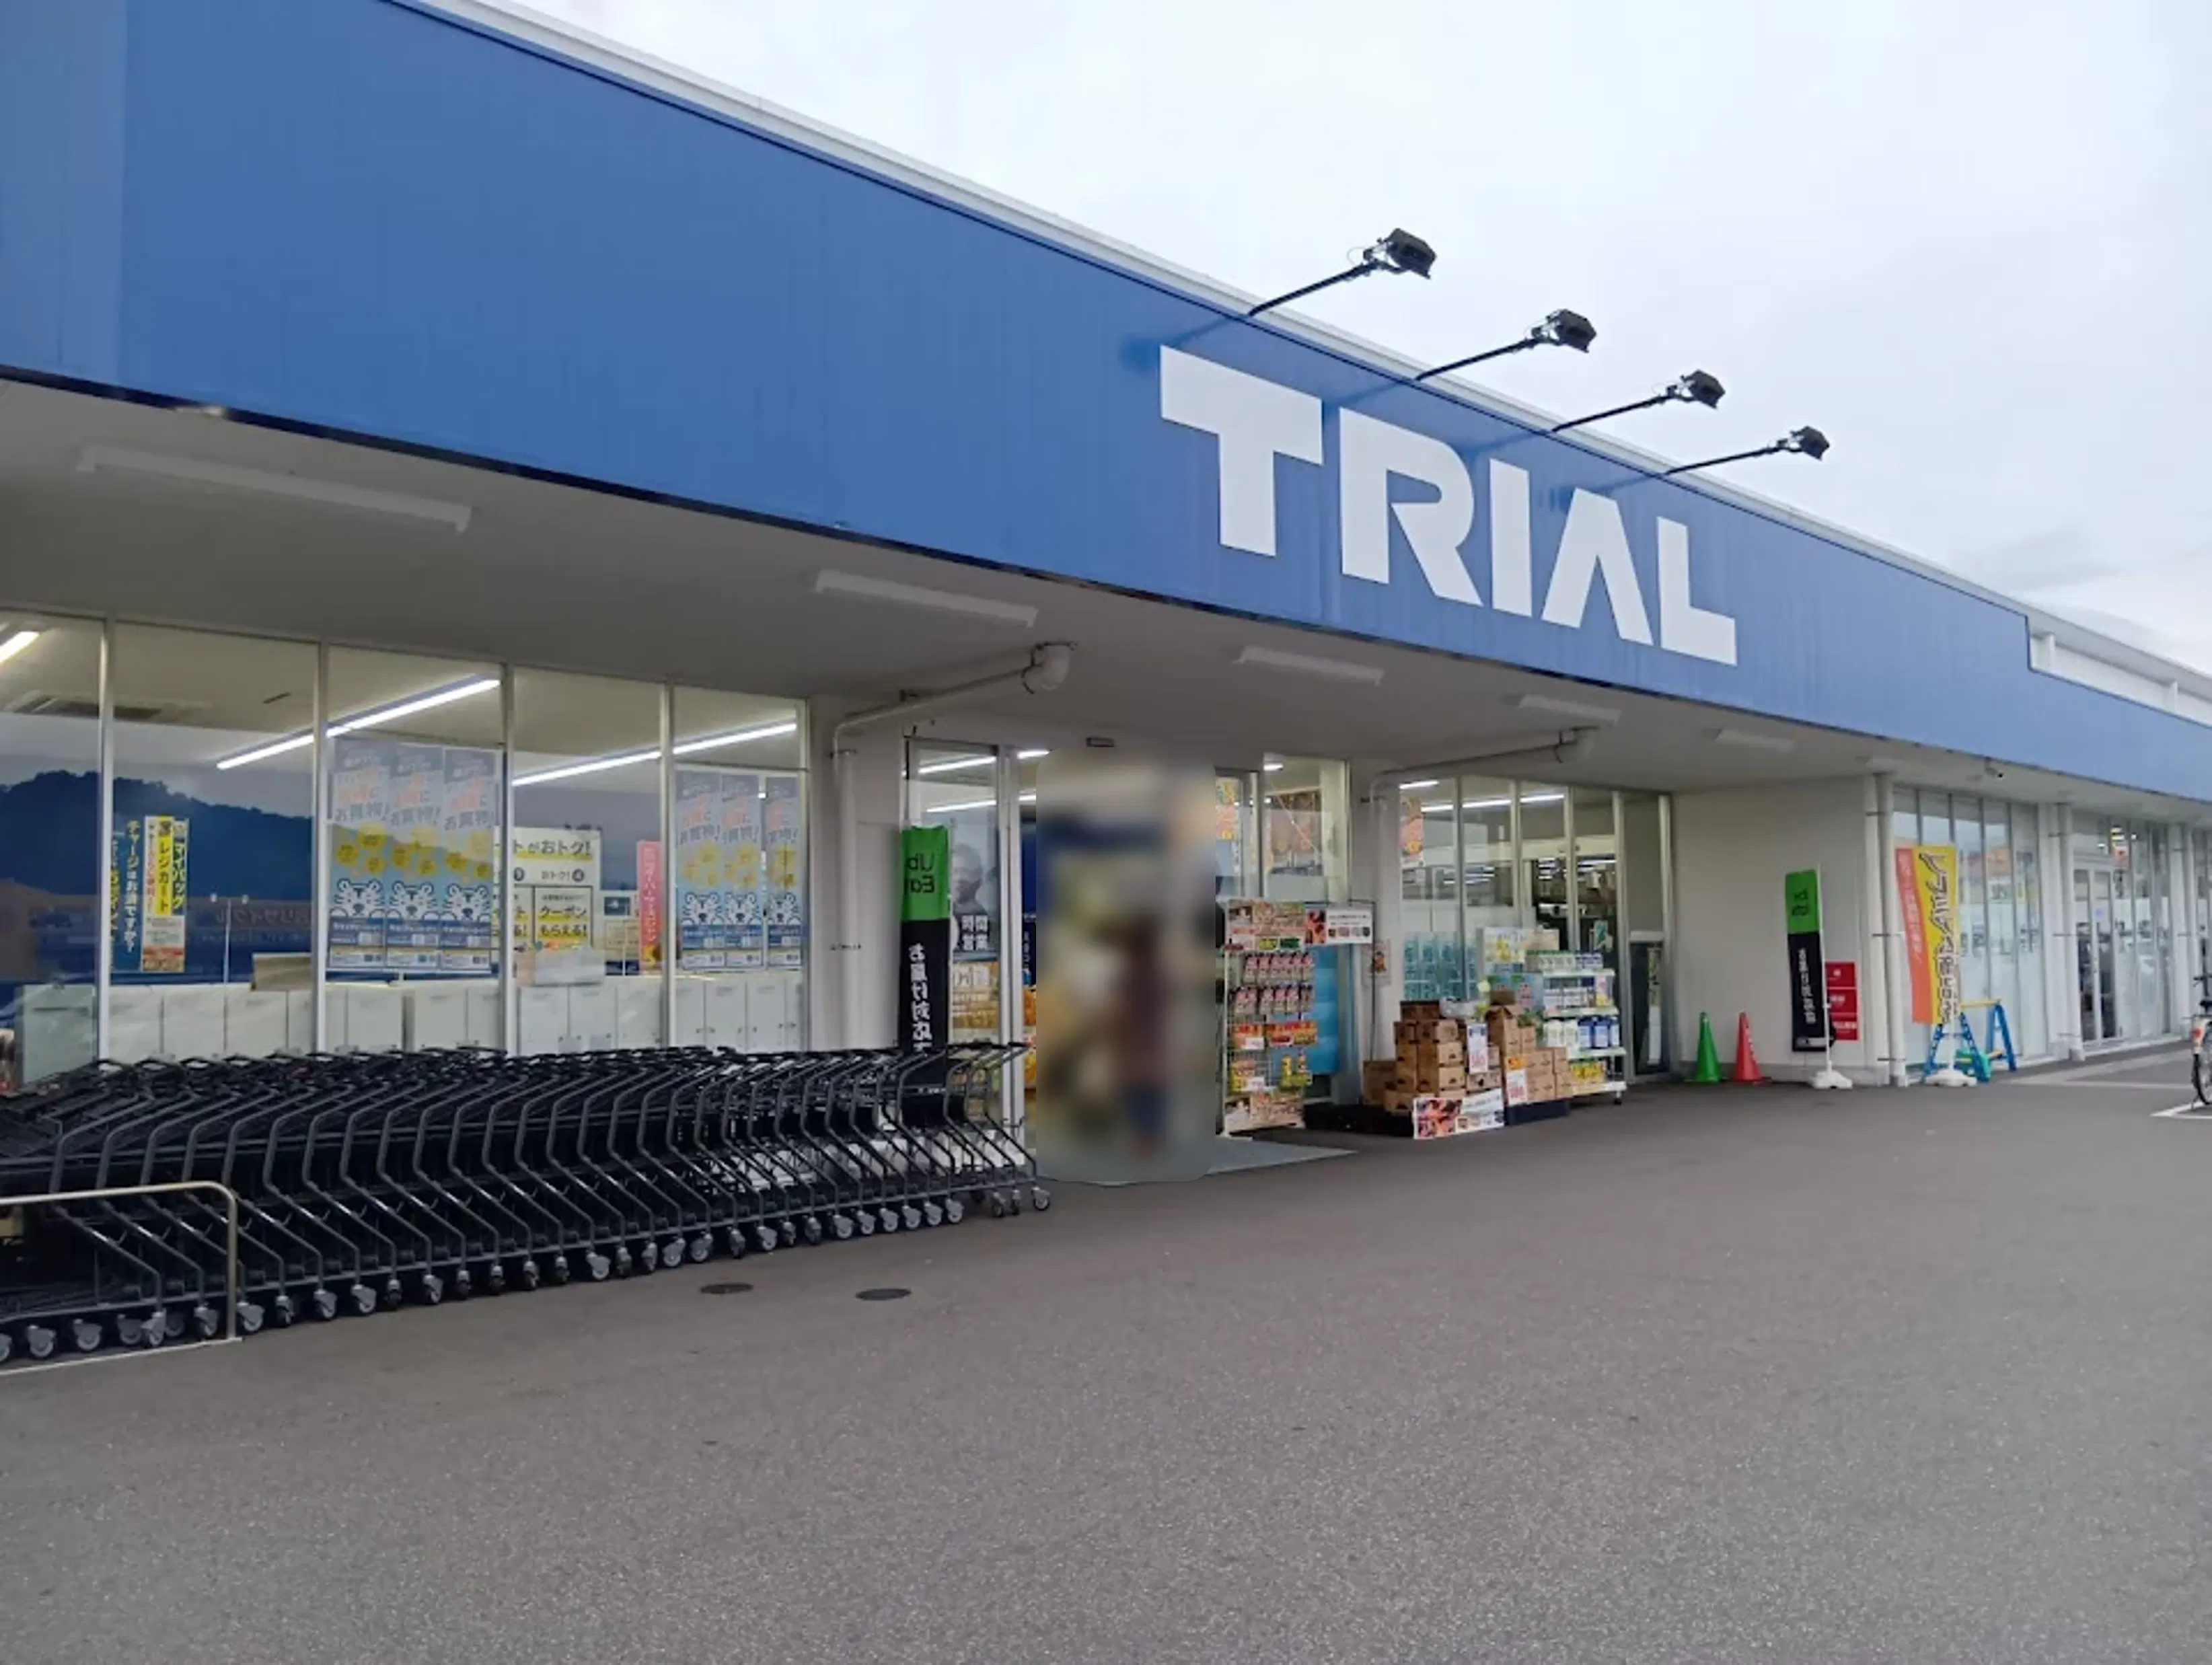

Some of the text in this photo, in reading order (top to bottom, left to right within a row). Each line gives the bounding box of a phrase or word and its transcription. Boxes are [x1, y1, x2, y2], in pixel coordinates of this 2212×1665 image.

[1160, 345, 1737, 666] TRIAL
[541, 906, 587, 919] クーポン
